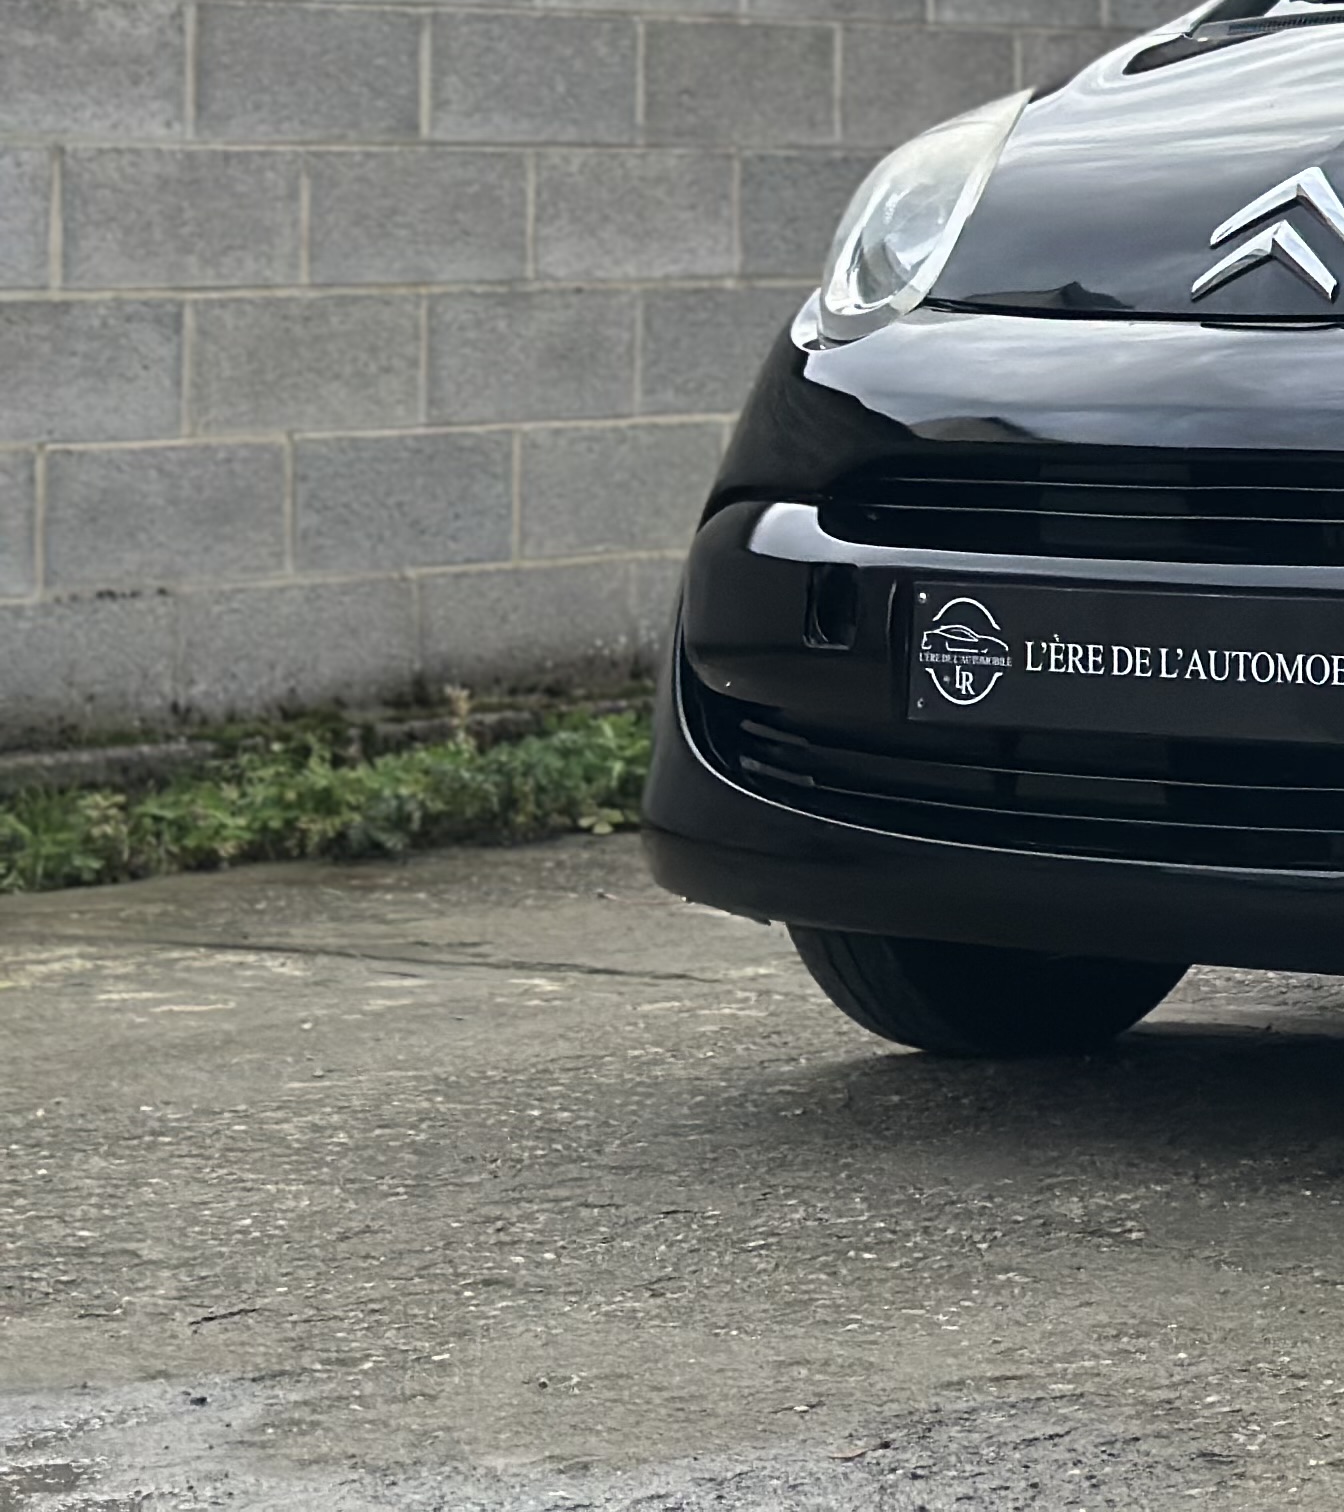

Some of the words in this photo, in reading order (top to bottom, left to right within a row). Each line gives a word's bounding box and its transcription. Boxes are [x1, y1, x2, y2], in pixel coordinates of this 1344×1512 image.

[1023, 633, 1106, 676] L'ÈRE
[1110, 644, 1153, 678] DE
[955, 664, 976, 695] LR
